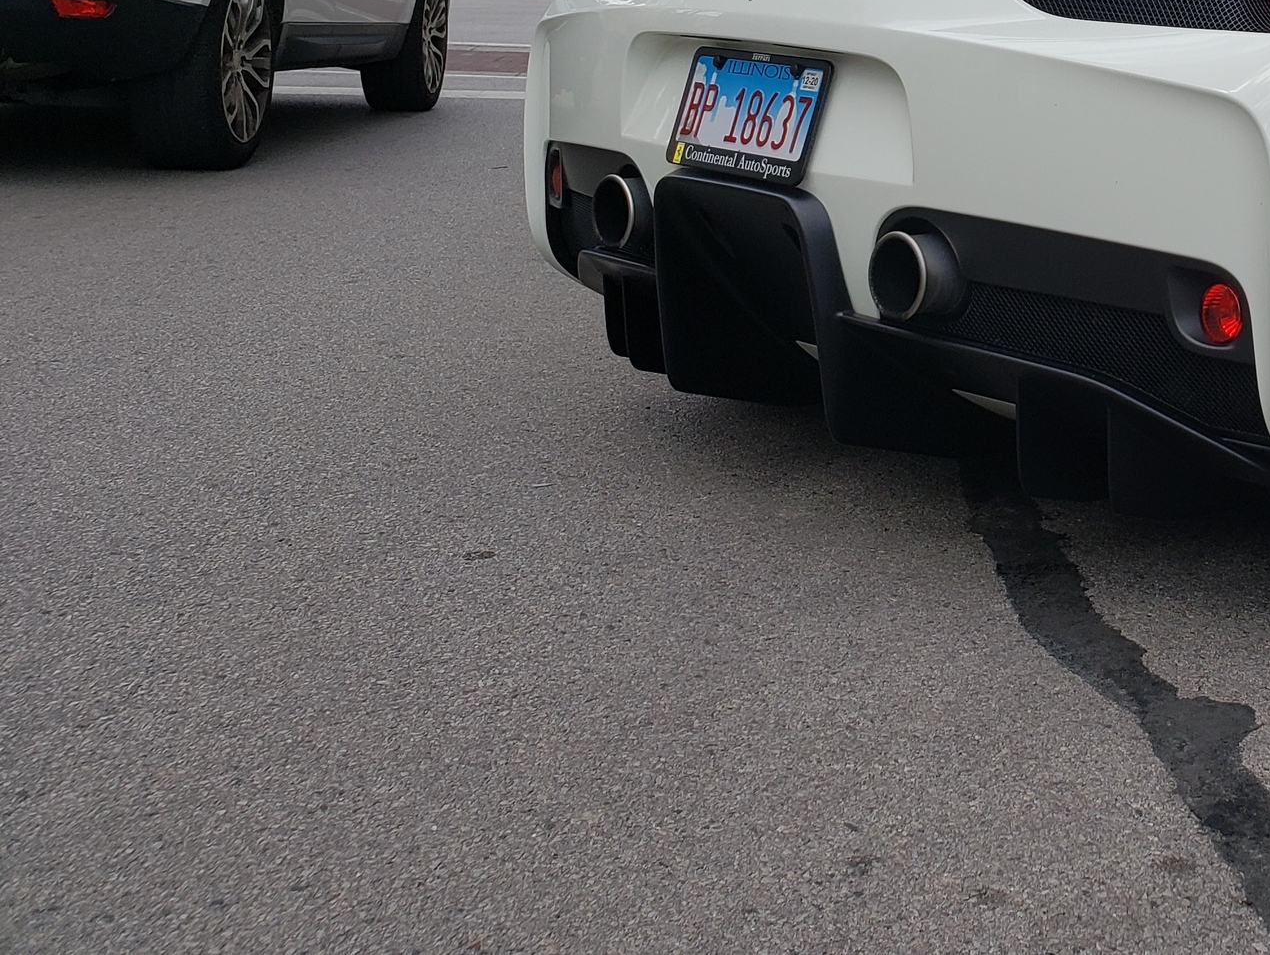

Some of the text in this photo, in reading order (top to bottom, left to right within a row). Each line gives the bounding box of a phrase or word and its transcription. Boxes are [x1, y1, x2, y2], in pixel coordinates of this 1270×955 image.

[726, 60, 792, 81] ILLINOIS
[680, 82, 814, 154] BP 18637
[685, 146, 792, 179] Continental AutoSports
